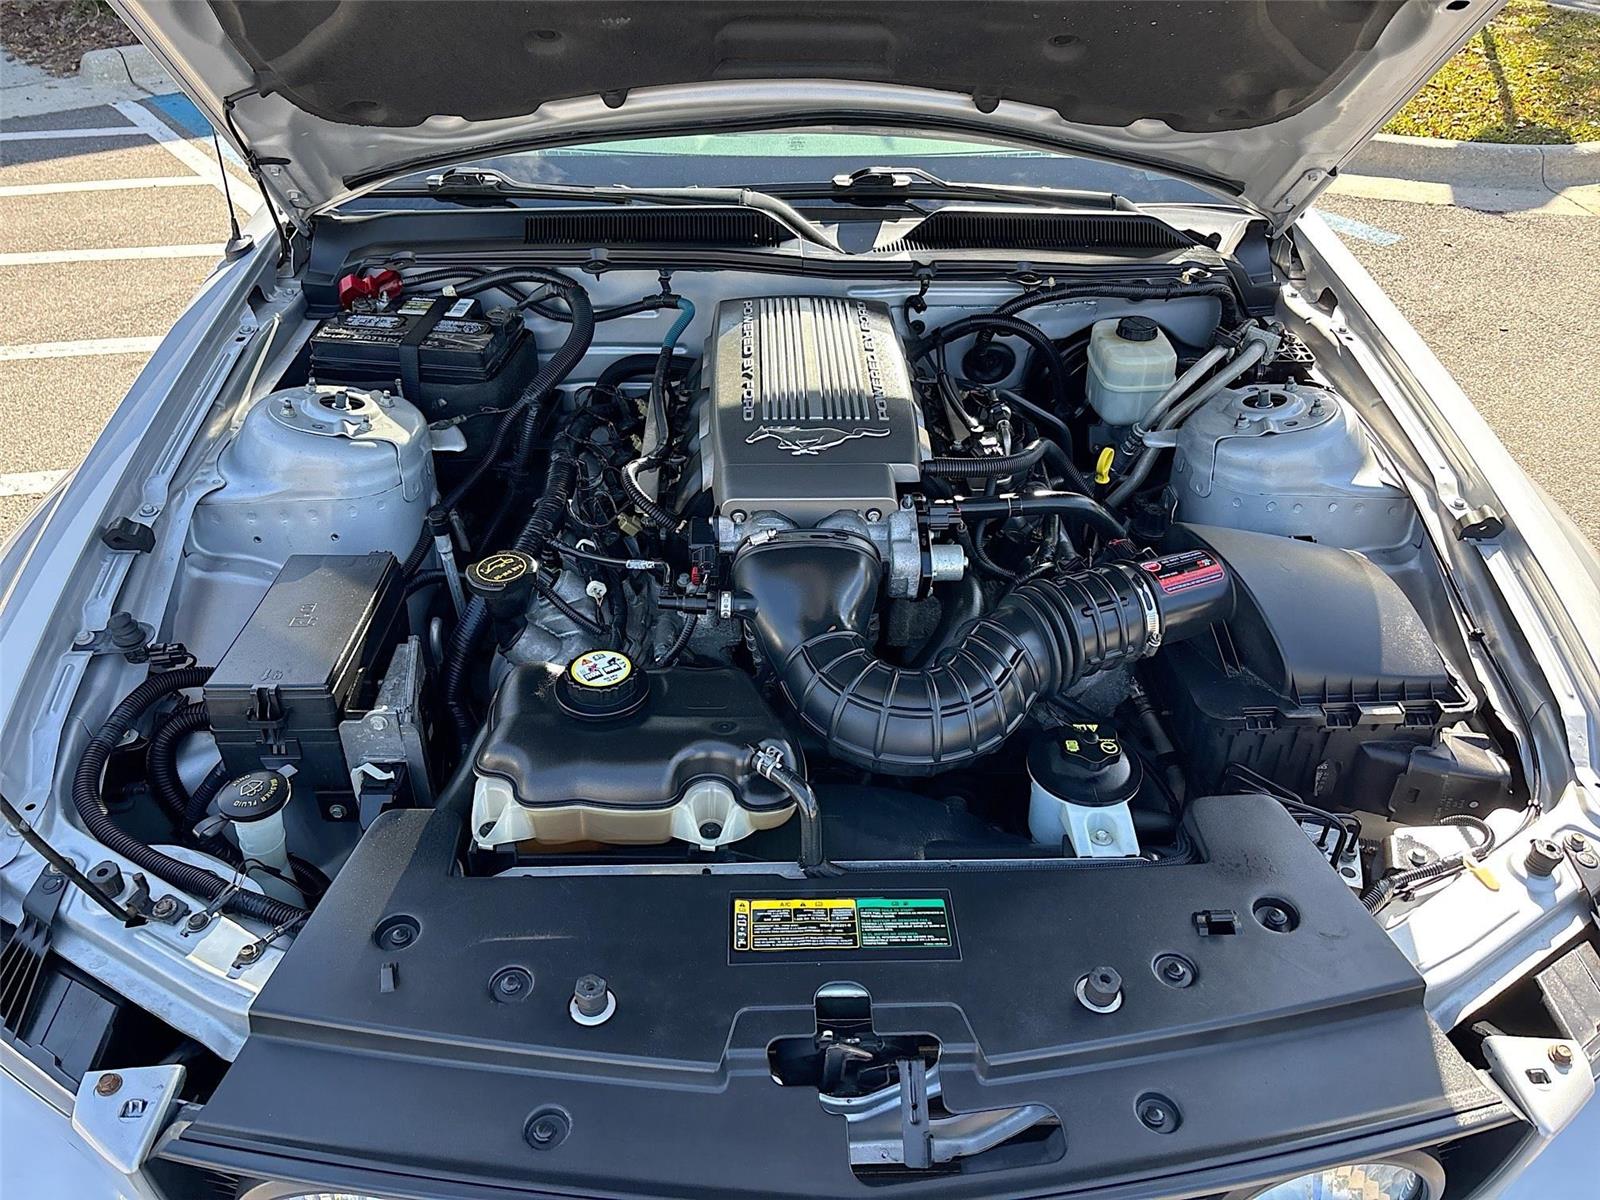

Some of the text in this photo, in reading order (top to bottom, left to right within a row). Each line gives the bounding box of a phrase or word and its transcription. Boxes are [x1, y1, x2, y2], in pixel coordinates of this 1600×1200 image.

[742, 300, 755, 421] POWERED BY FORD
[857, 301, 890, 421] POWERED BY FORD
[233, 800, 257, 808] FLUID
